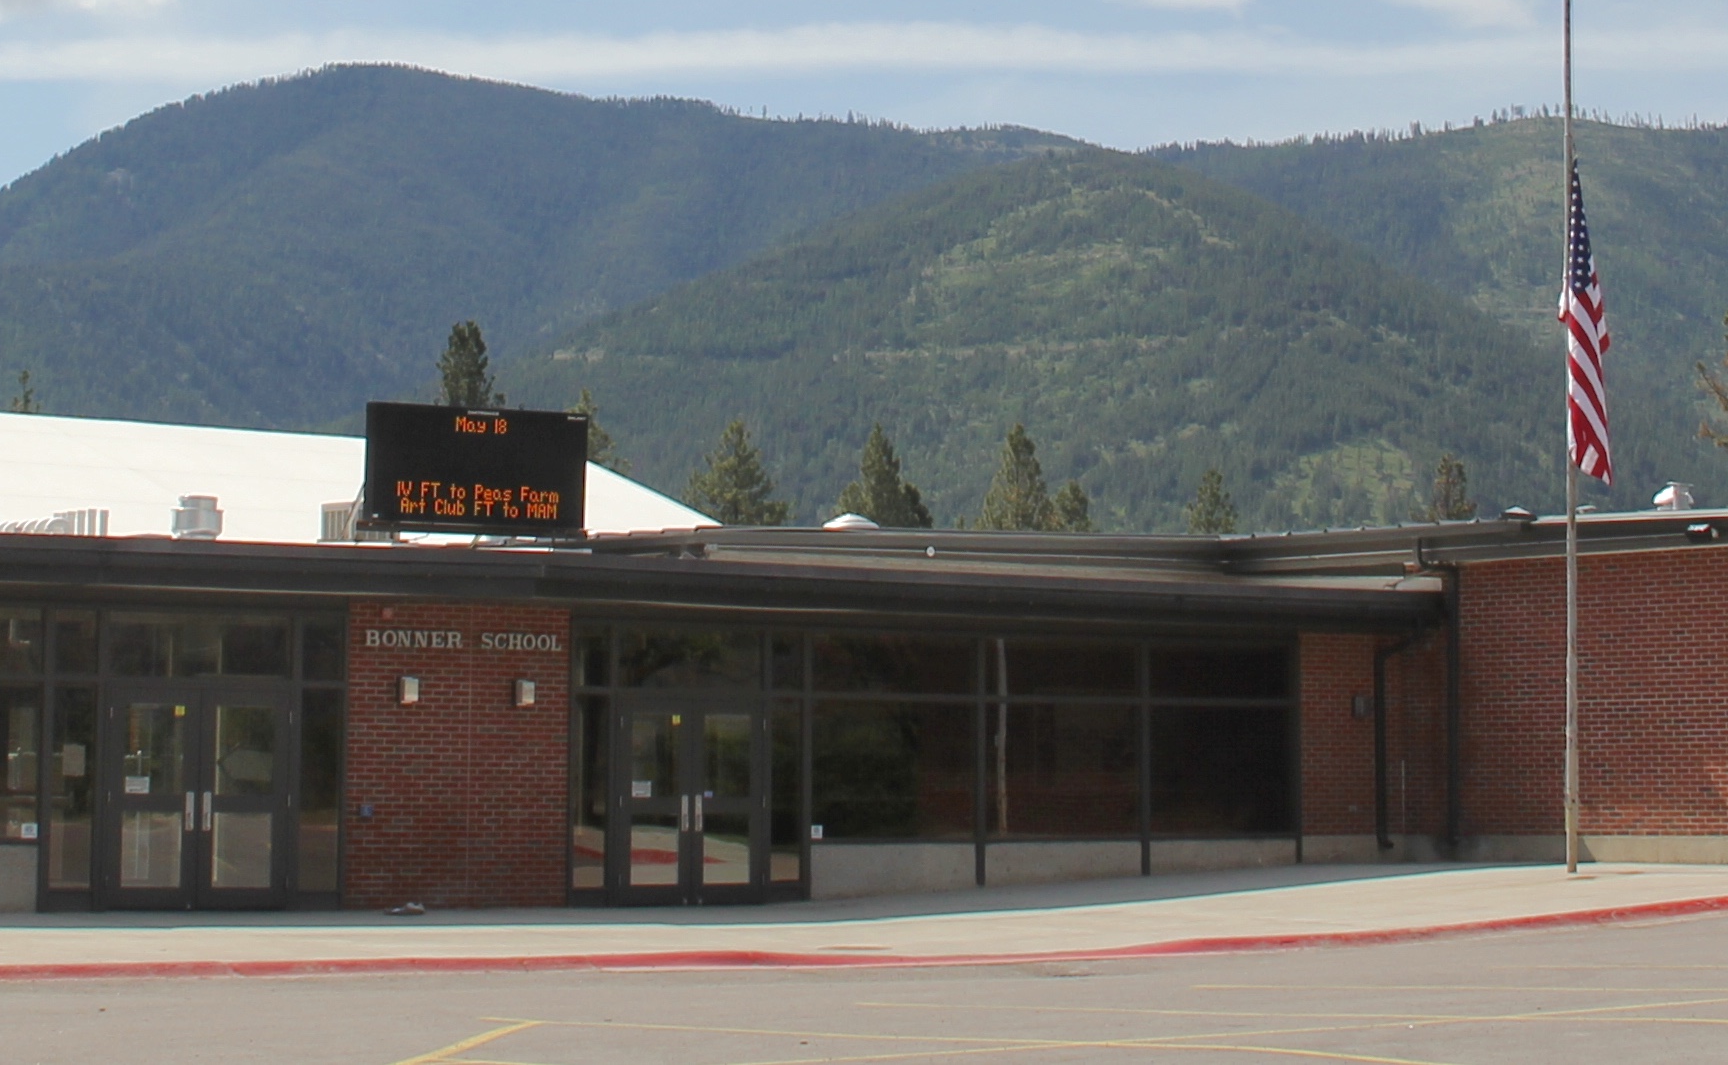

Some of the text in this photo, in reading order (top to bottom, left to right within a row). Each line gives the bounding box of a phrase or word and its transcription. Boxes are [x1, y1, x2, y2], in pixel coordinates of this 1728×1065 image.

[456, 416, 508, 434] May 18
[420, 481, 441, 498] FT
[450, 483, 466, 499] to
[474, 484, 512, 501] Peas
[519, 486, 559, 503] Farm
[400, 497, 558, 520] Art Club FT to MAM
[364, 629, 562, 652] BONNER SCHOOL
